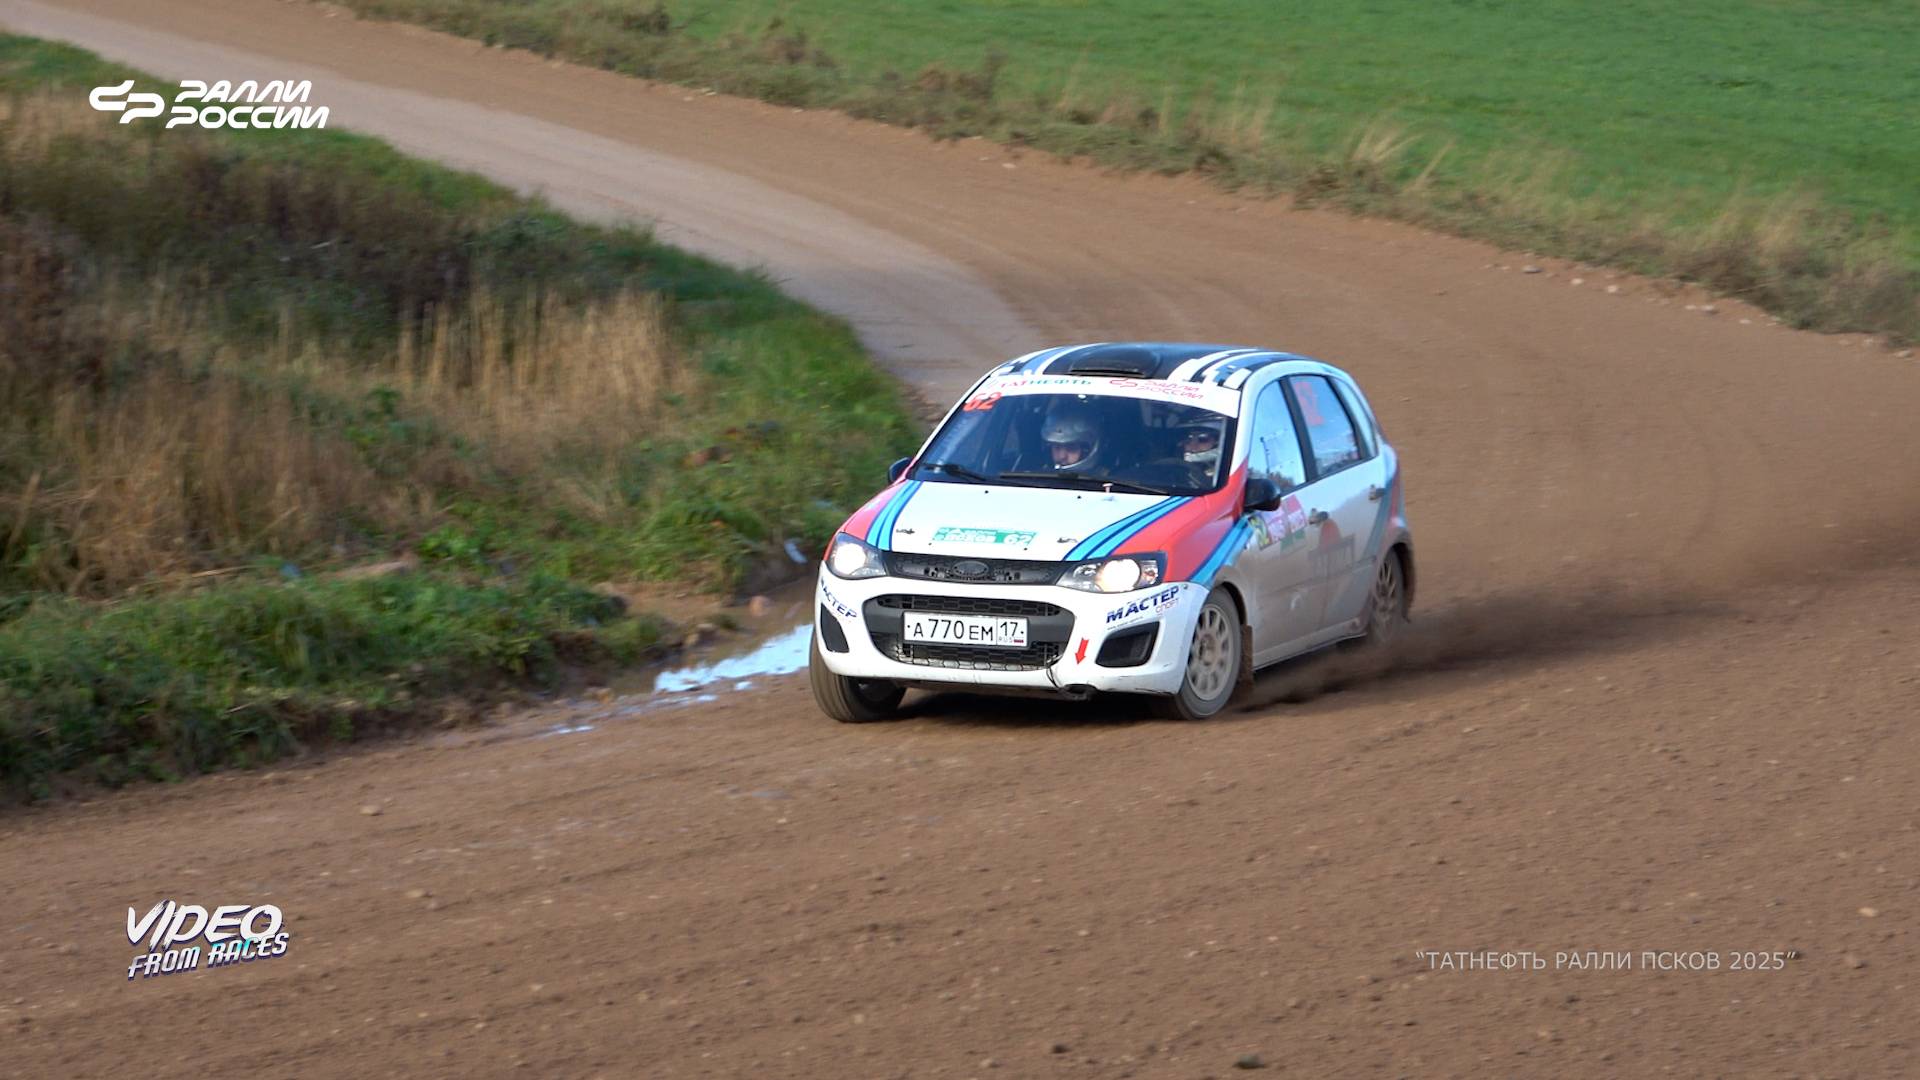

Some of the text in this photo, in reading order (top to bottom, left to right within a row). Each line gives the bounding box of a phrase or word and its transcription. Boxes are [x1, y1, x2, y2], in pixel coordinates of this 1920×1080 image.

[962, 391, 1003, 412] 62
[1001, 533, 1032, 545] 62
[1106, 585, 1179, 623] МАСТЕР
[1000, 621, 1019, 637] 17
